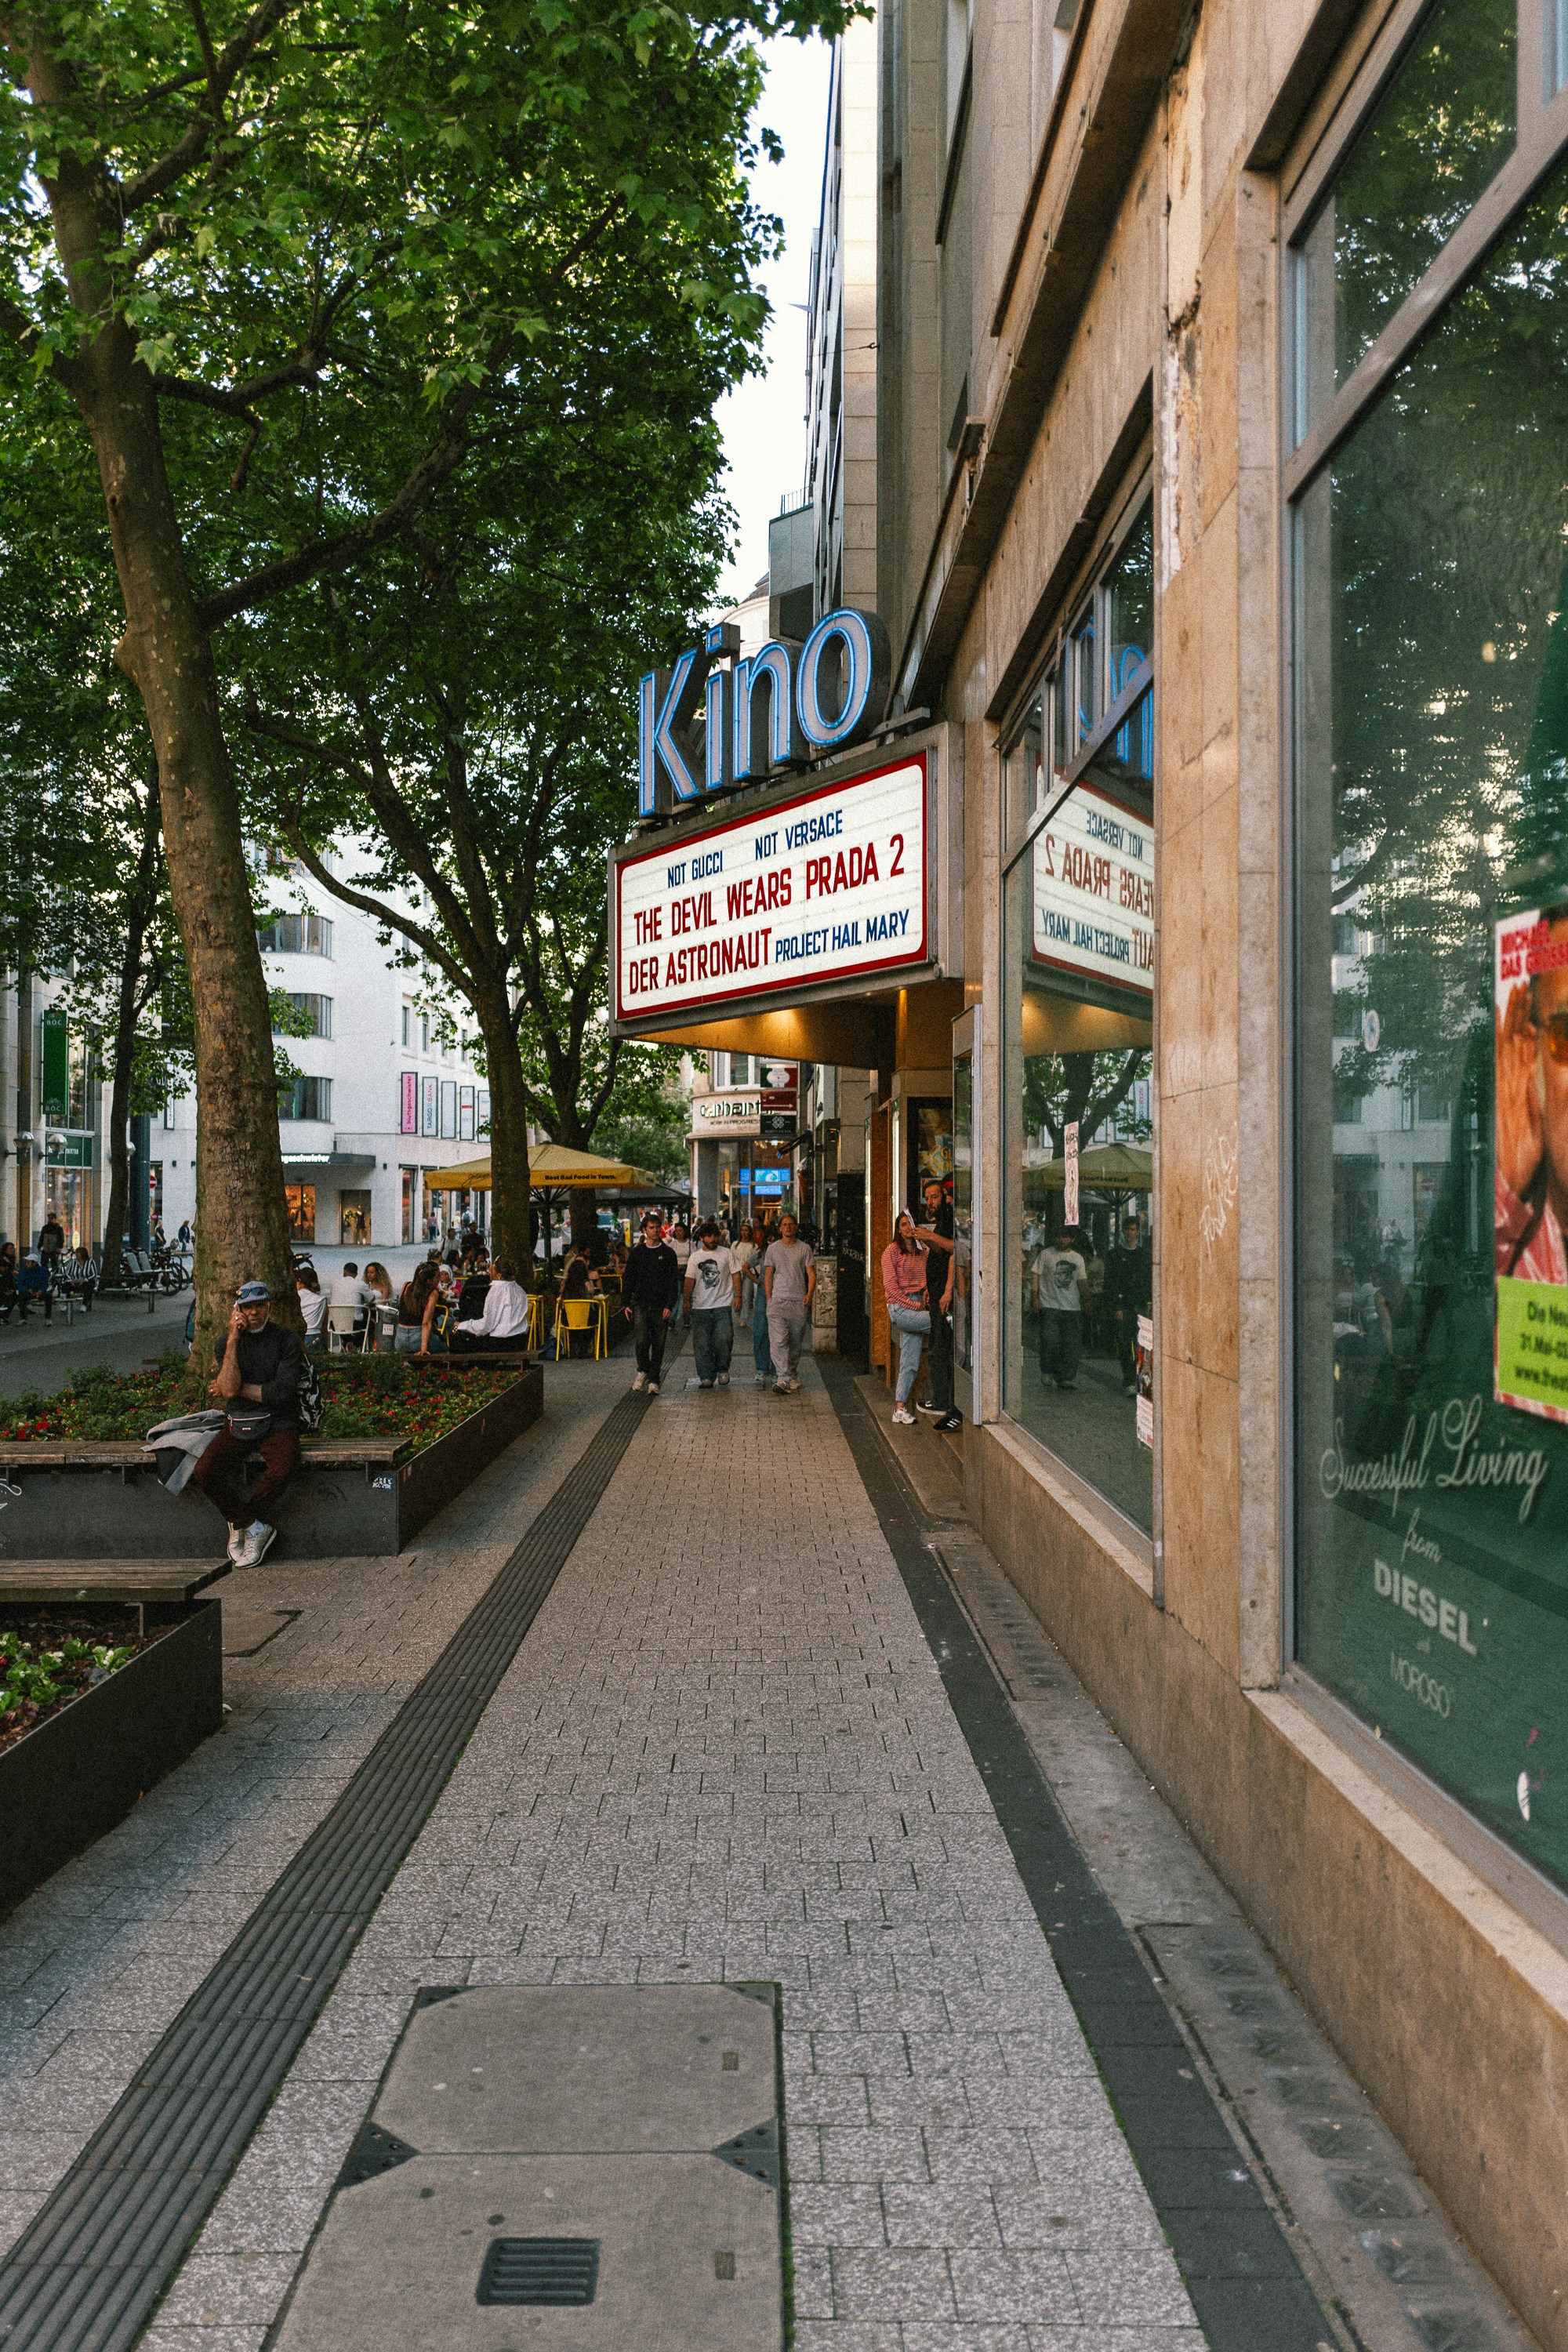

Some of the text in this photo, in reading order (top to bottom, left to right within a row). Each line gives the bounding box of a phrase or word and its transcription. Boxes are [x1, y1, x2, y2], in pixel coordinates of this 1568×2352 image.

[639, 608, 872, 818] Kino
[633, 833, 905, 946] THE DEVIL WEARS PRADA 2
[667, 809, 843, 889] NOT GUCCI NOT VERSACE
[630, 909, 909, 994] DER ASTRONAUT PROJECT HAIL MARY
[700, 1099, 774, 1117] carhart
[1319, 1394, 1548, 1524] Successful Living
[1401, 1507, 1443, 1563] from
[1374, 1559, 1478, 1657] DIESEL
